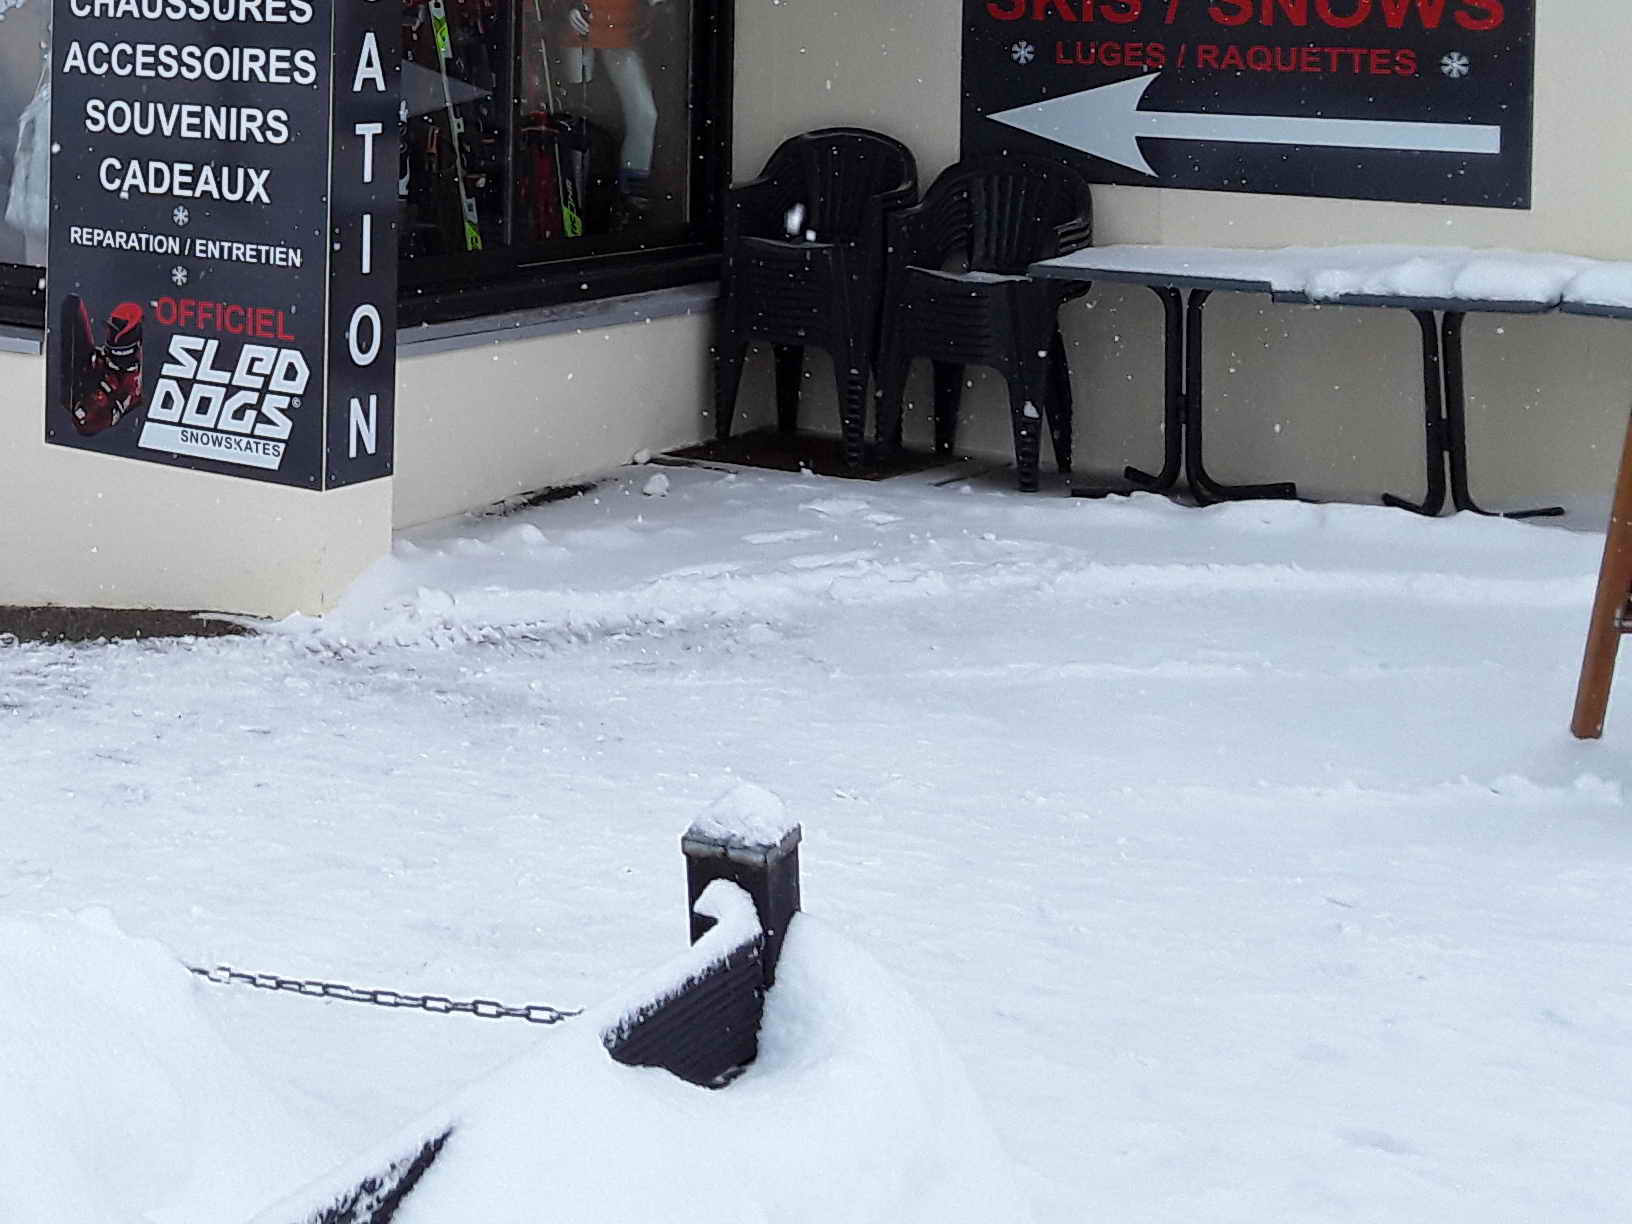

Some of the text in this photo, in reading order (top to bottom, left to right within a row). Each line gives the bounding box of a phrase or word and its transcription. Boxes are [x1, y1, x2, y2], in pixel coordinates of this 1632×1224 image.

[63, 42, 317, 85] ACCESSOIRES
[1055, 40, 1166, 68] LUGES
[1198, 45, 1417, 75] RAQUETTES
[85, 99, 289, 144] SOUVENIRS
[99, 157, 271, 203] CADEAUX
[70, 226, 180, 255] REPARATION
[195, 239, 302, 267] ENTRETIEN
[155, 297, 295, 341] OFFICIEL
[147, 378, 293, 440] DOGS
[180, 429, 281, 457] SNOWSKATES
